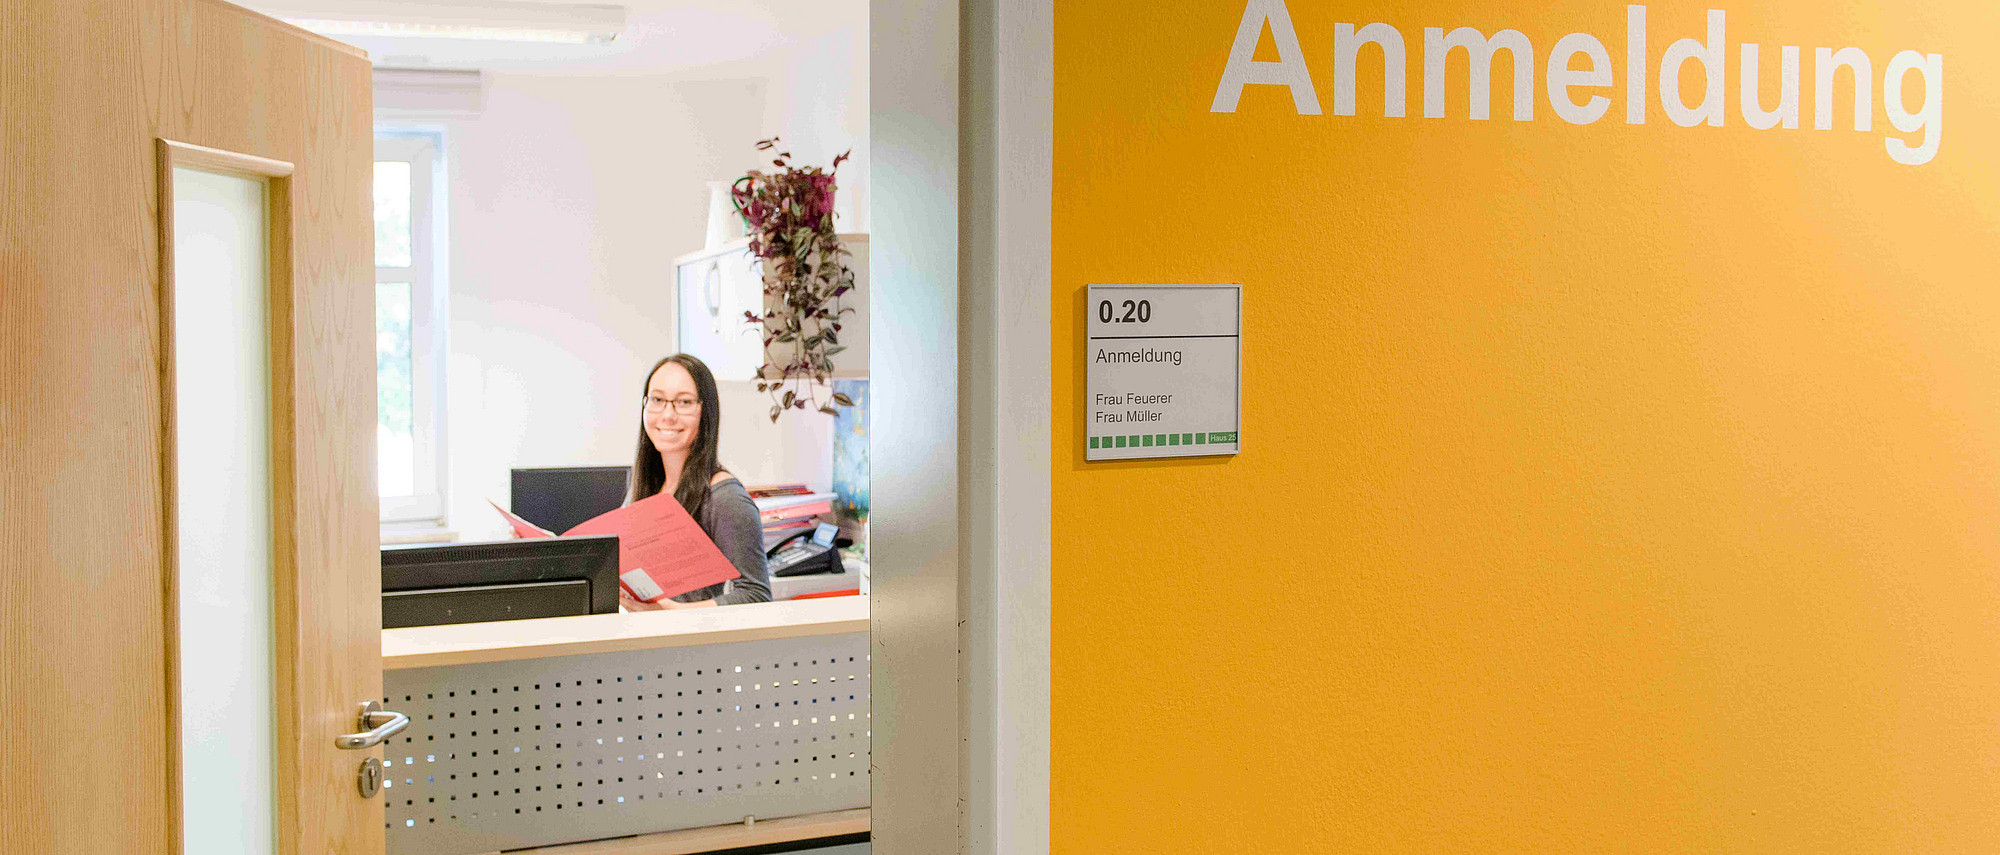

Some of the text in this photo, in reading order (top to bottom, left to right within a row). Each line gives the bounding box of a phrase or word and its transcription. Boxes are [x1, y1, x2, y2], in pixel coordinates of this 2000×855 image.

[1210, 0, 1944, 165] Anmeldung
[1099, 299, 1151, 324] 0.20
[1095, 348, 1182, 366] Anmeldung
[1096, 393, 1173, 406] Frau Feuerer
[1096, 410, 1163, 423] Frau Müller
[1210, 433, 1237, 442] Haus 25
